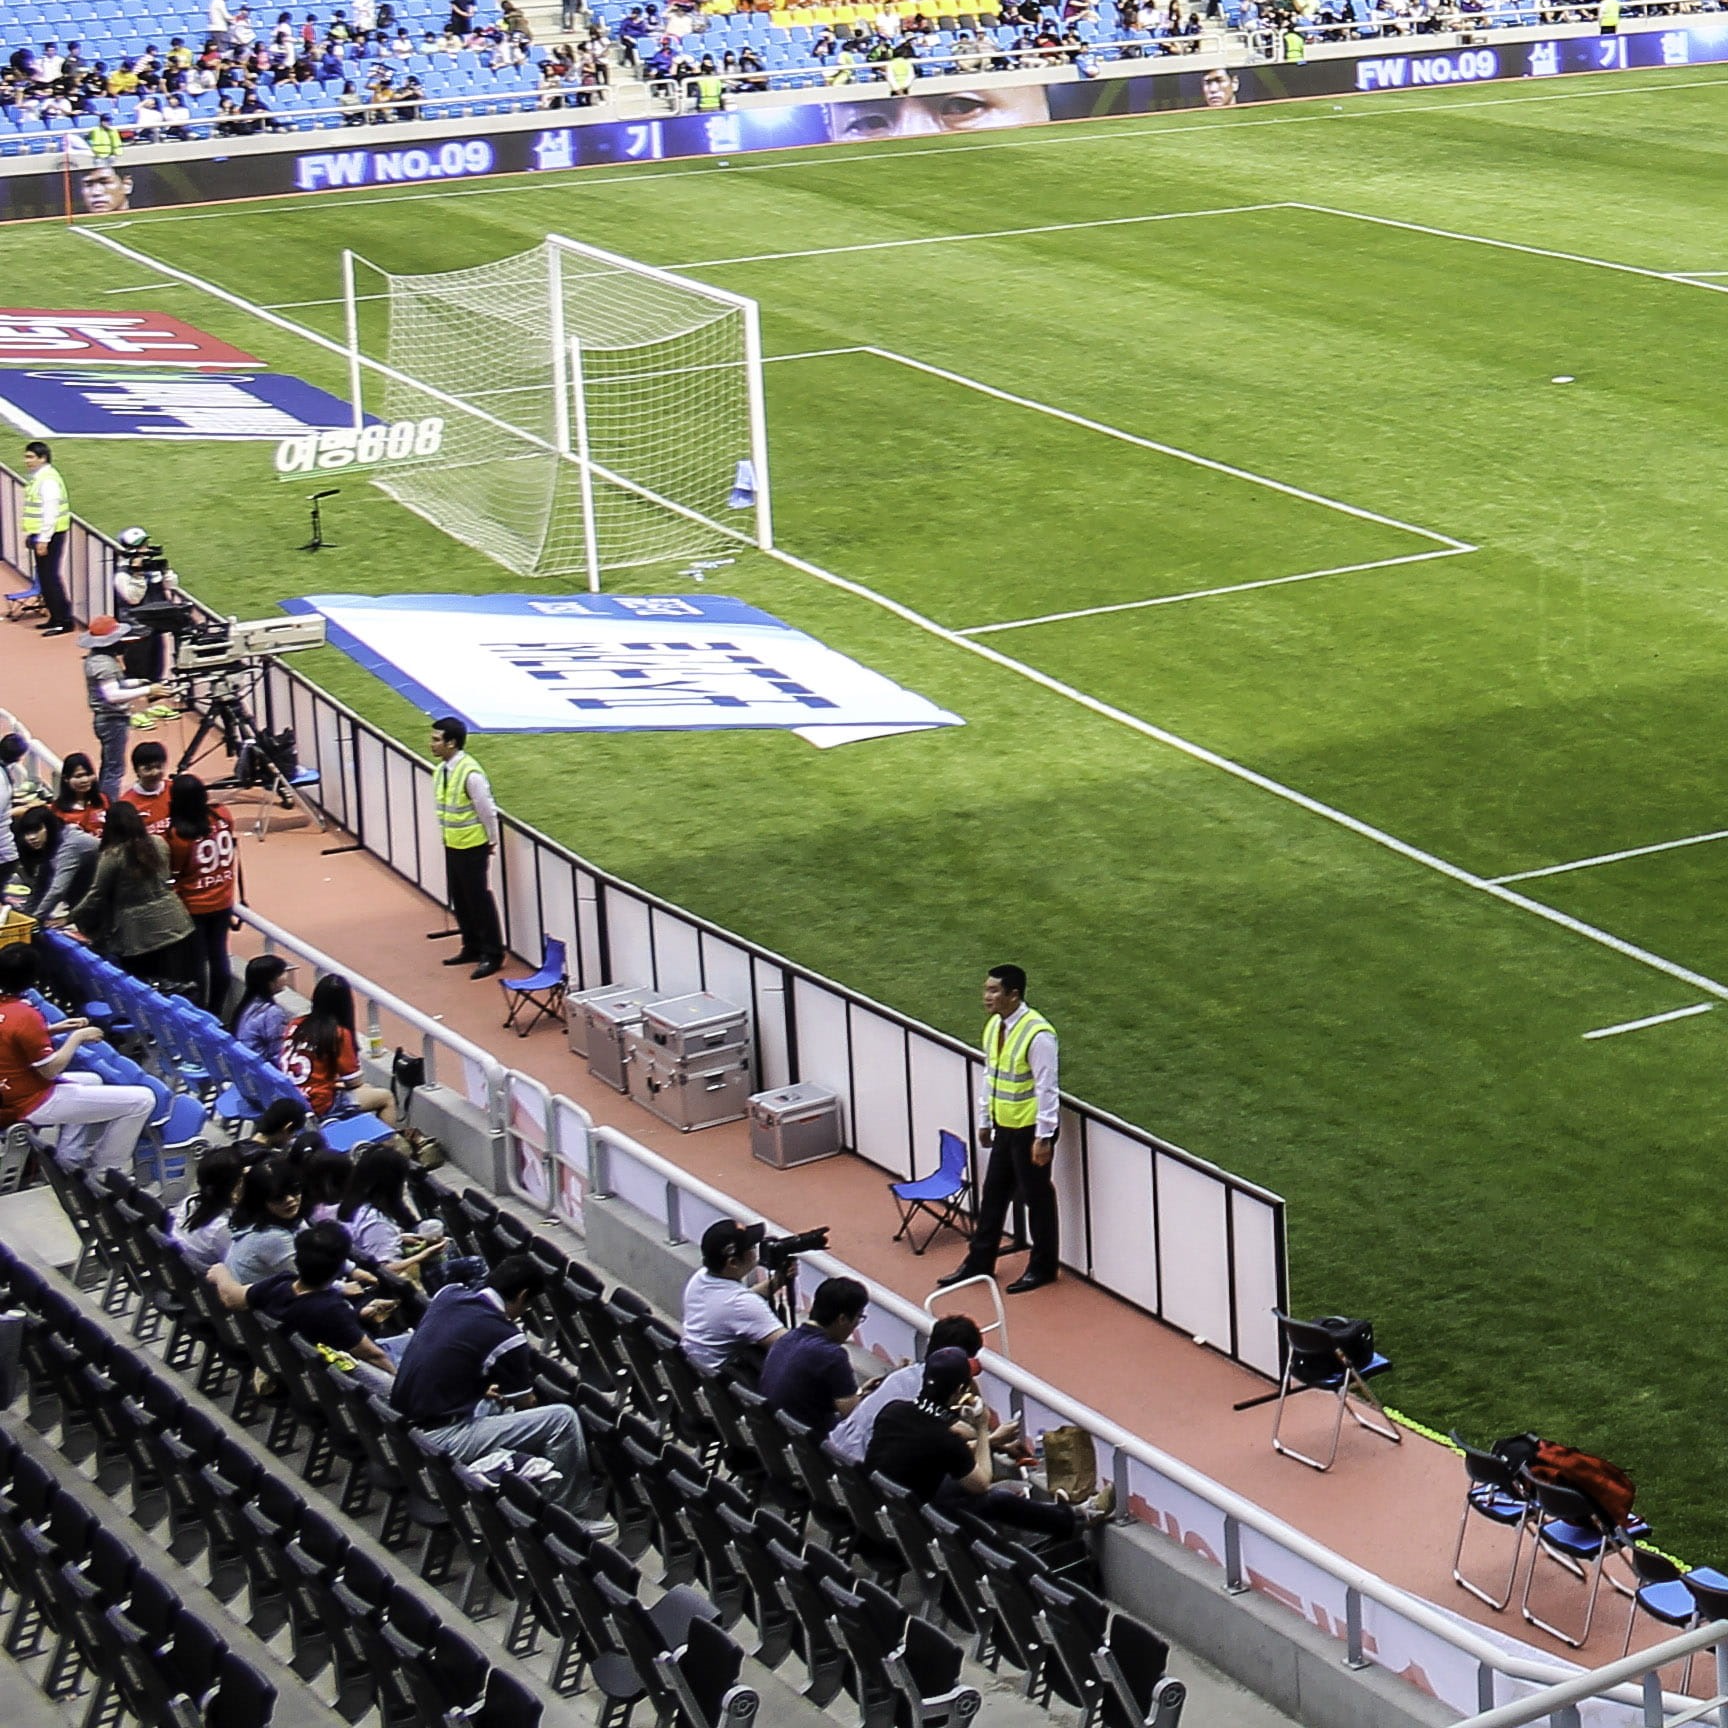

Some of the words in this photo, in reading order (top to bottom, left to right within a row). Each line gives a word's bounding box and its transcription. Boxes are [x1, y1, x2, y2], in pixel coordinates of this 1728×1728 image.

[1357, 58, 1406, 90] FW
[1412, 50, 1497, 83] NO.09
[1600, 36, 1628, 69] 기
[297, 152, 367, 191] FW
[373, 141, 492, 181] NO.09
[625, 121, 663, 160] 기
[196, 829, 234, 874] 99
